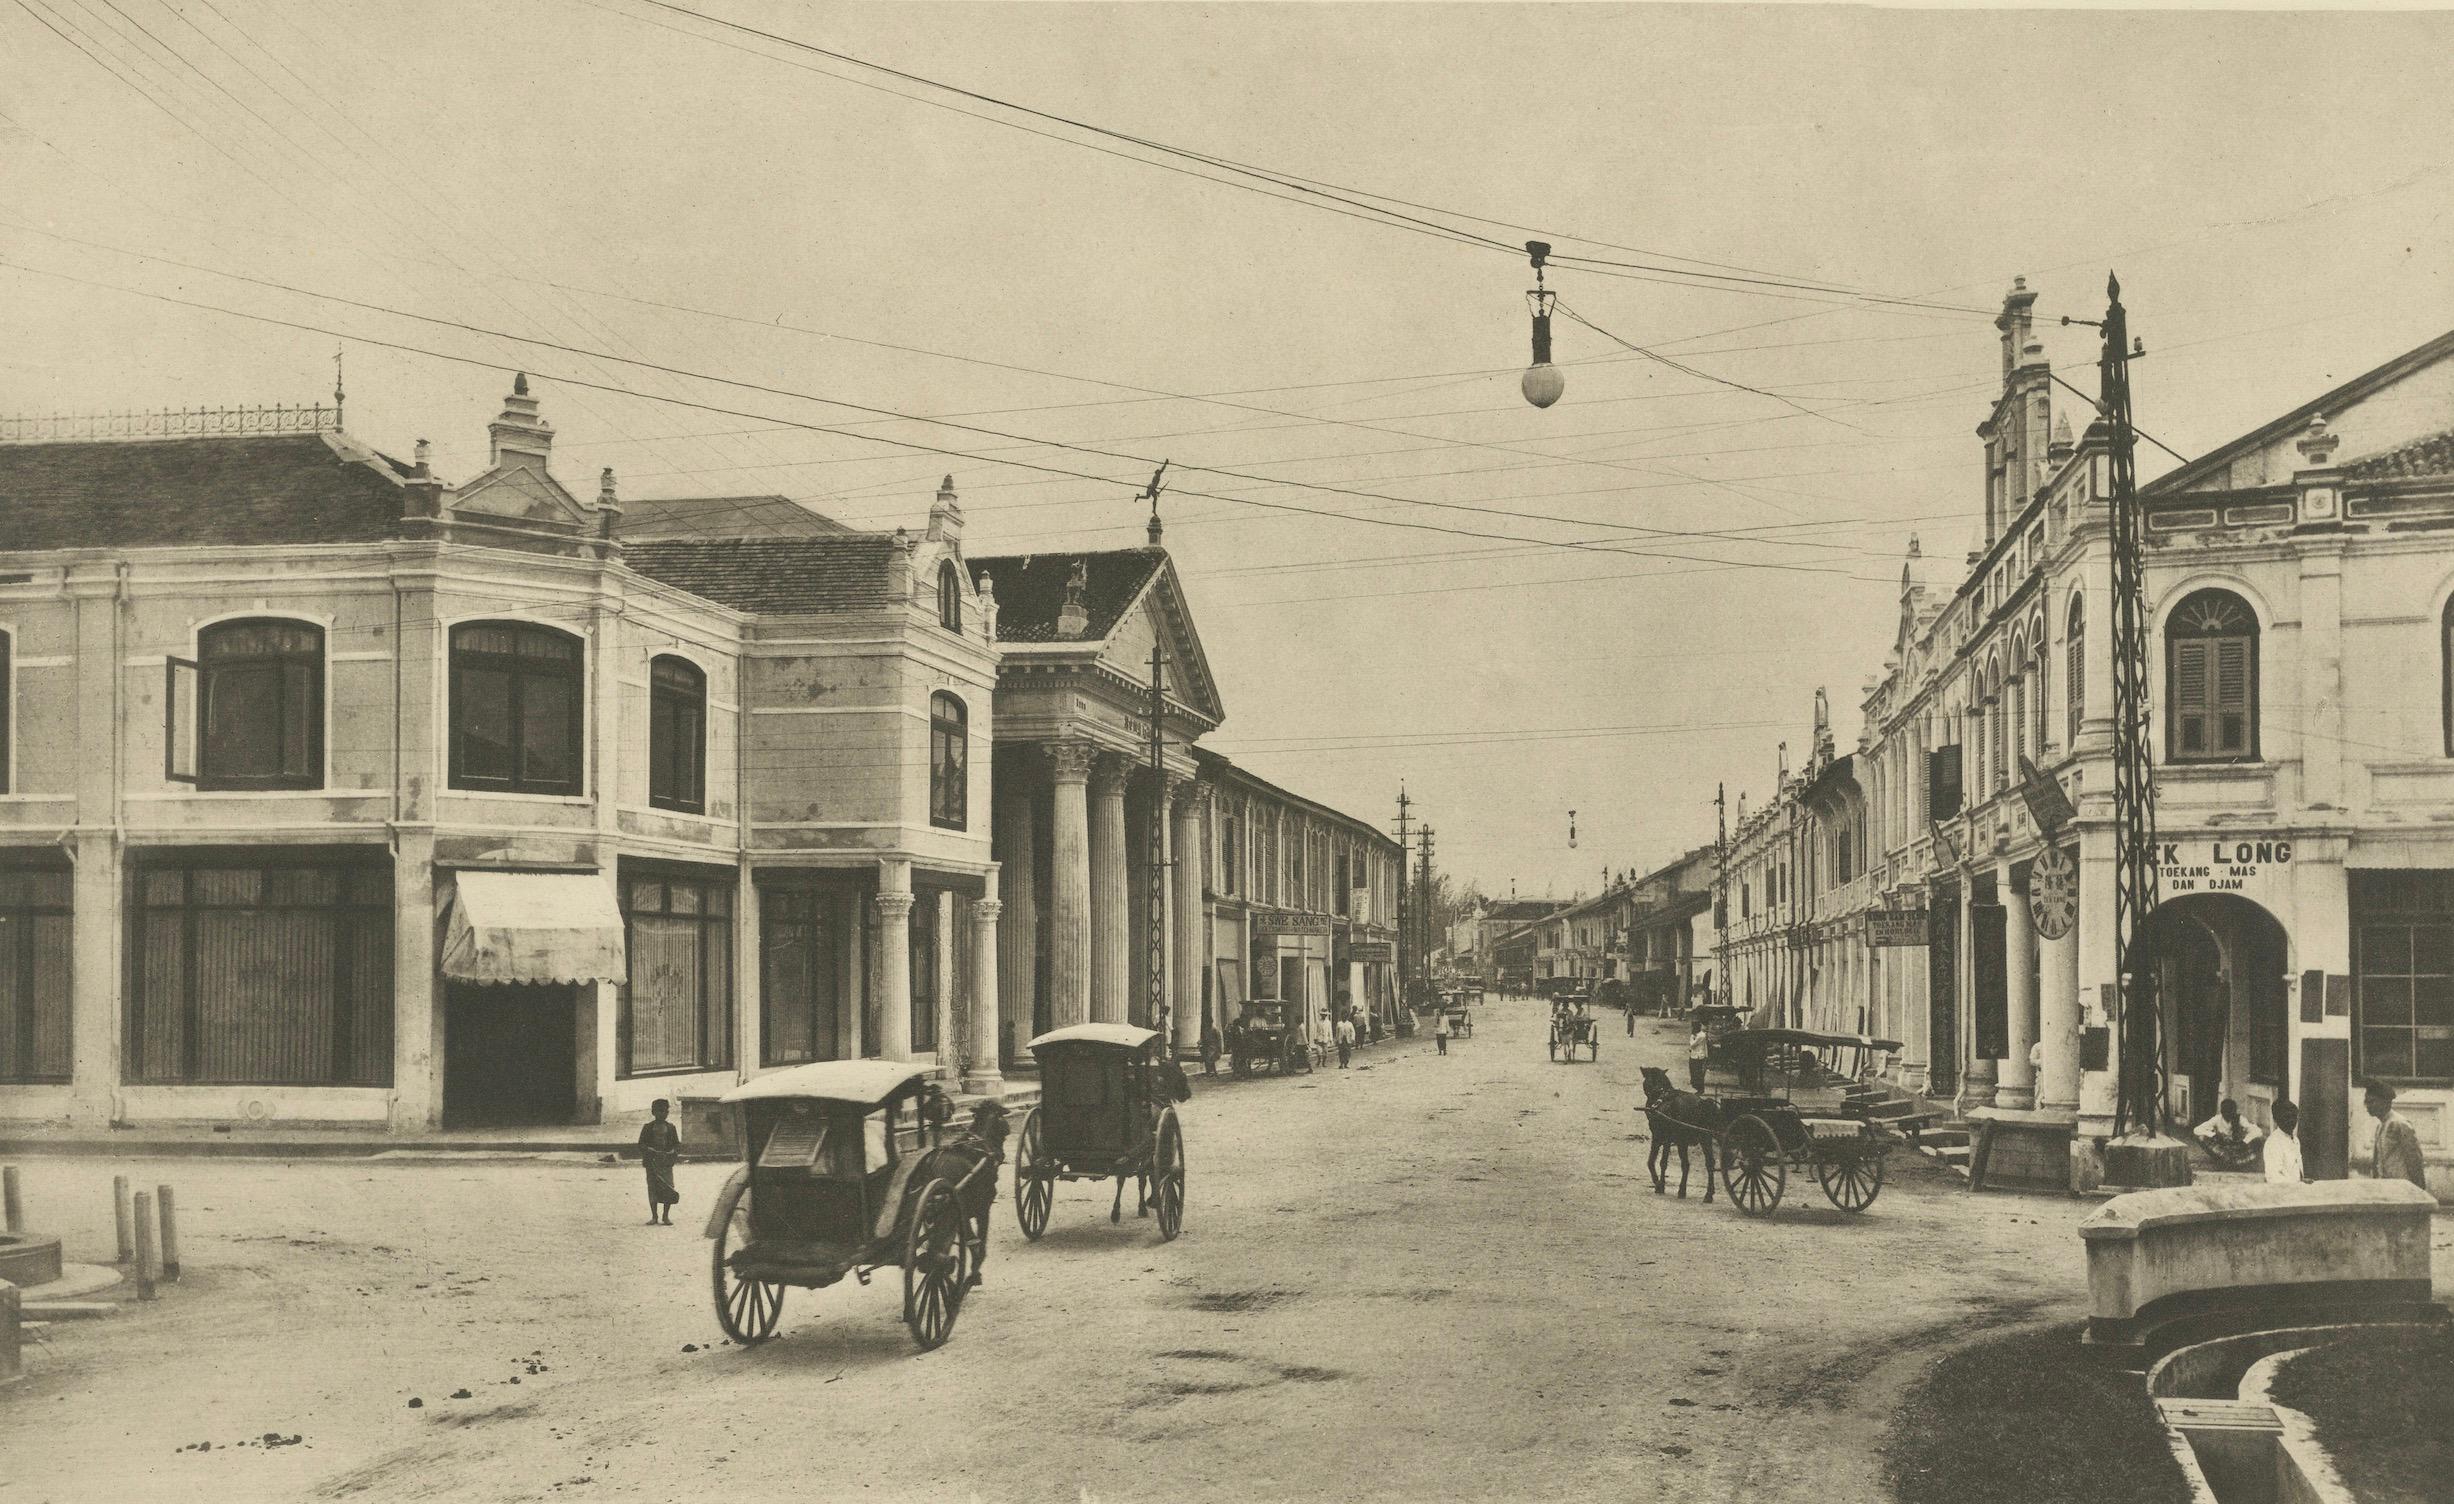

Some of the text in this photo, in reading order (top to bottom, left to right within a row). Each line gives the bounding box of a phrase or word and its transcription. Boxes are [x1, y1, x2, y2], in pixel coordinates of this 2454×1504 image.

[2213, 842, 2292, 864] LONG
[2159, 866, 2256, 878] TOEKANG MAS
[2172, 879, 2243, 890] DAN DJAM
[1292, 916, 1319, 926] SANG
